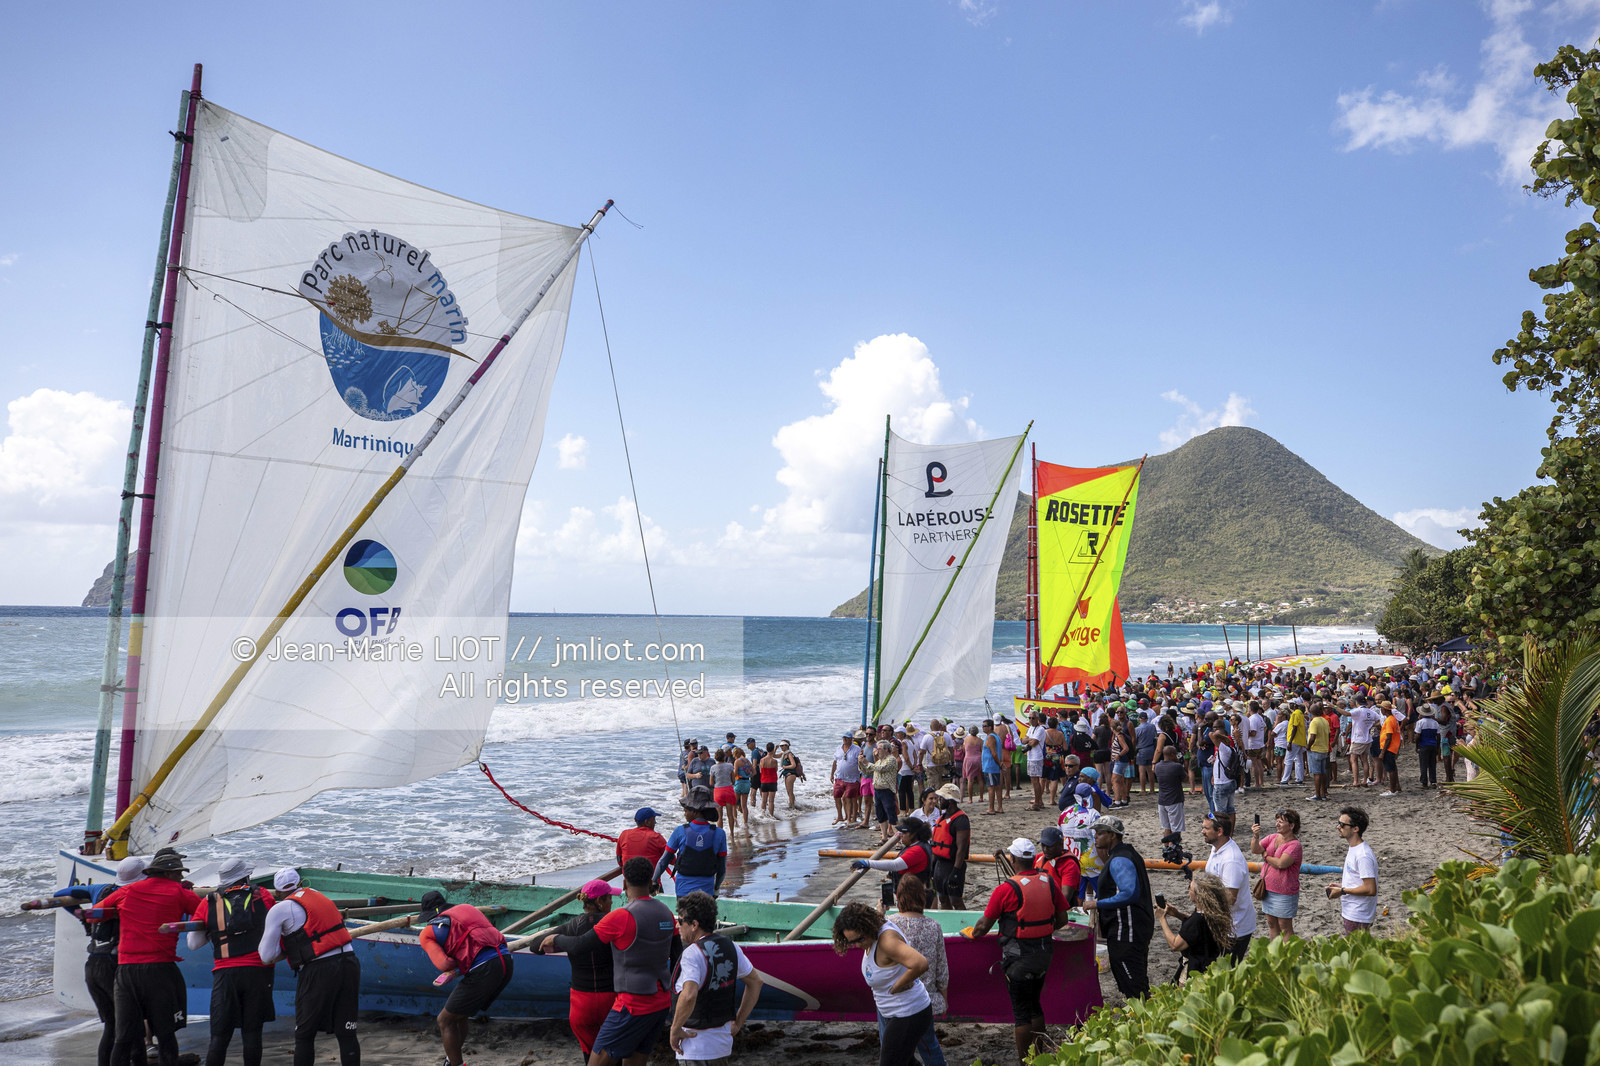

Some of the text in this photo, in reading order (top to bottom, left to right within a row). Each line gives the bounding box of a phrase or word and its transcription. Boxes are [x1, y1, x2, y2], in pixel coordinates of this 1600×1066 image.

[345, 231, 429, 274] naturel
[427, 270, 467, 343] marin
[332, 427, 423, 458] Martiniqu
[335, 607, 401, 637] OFB
